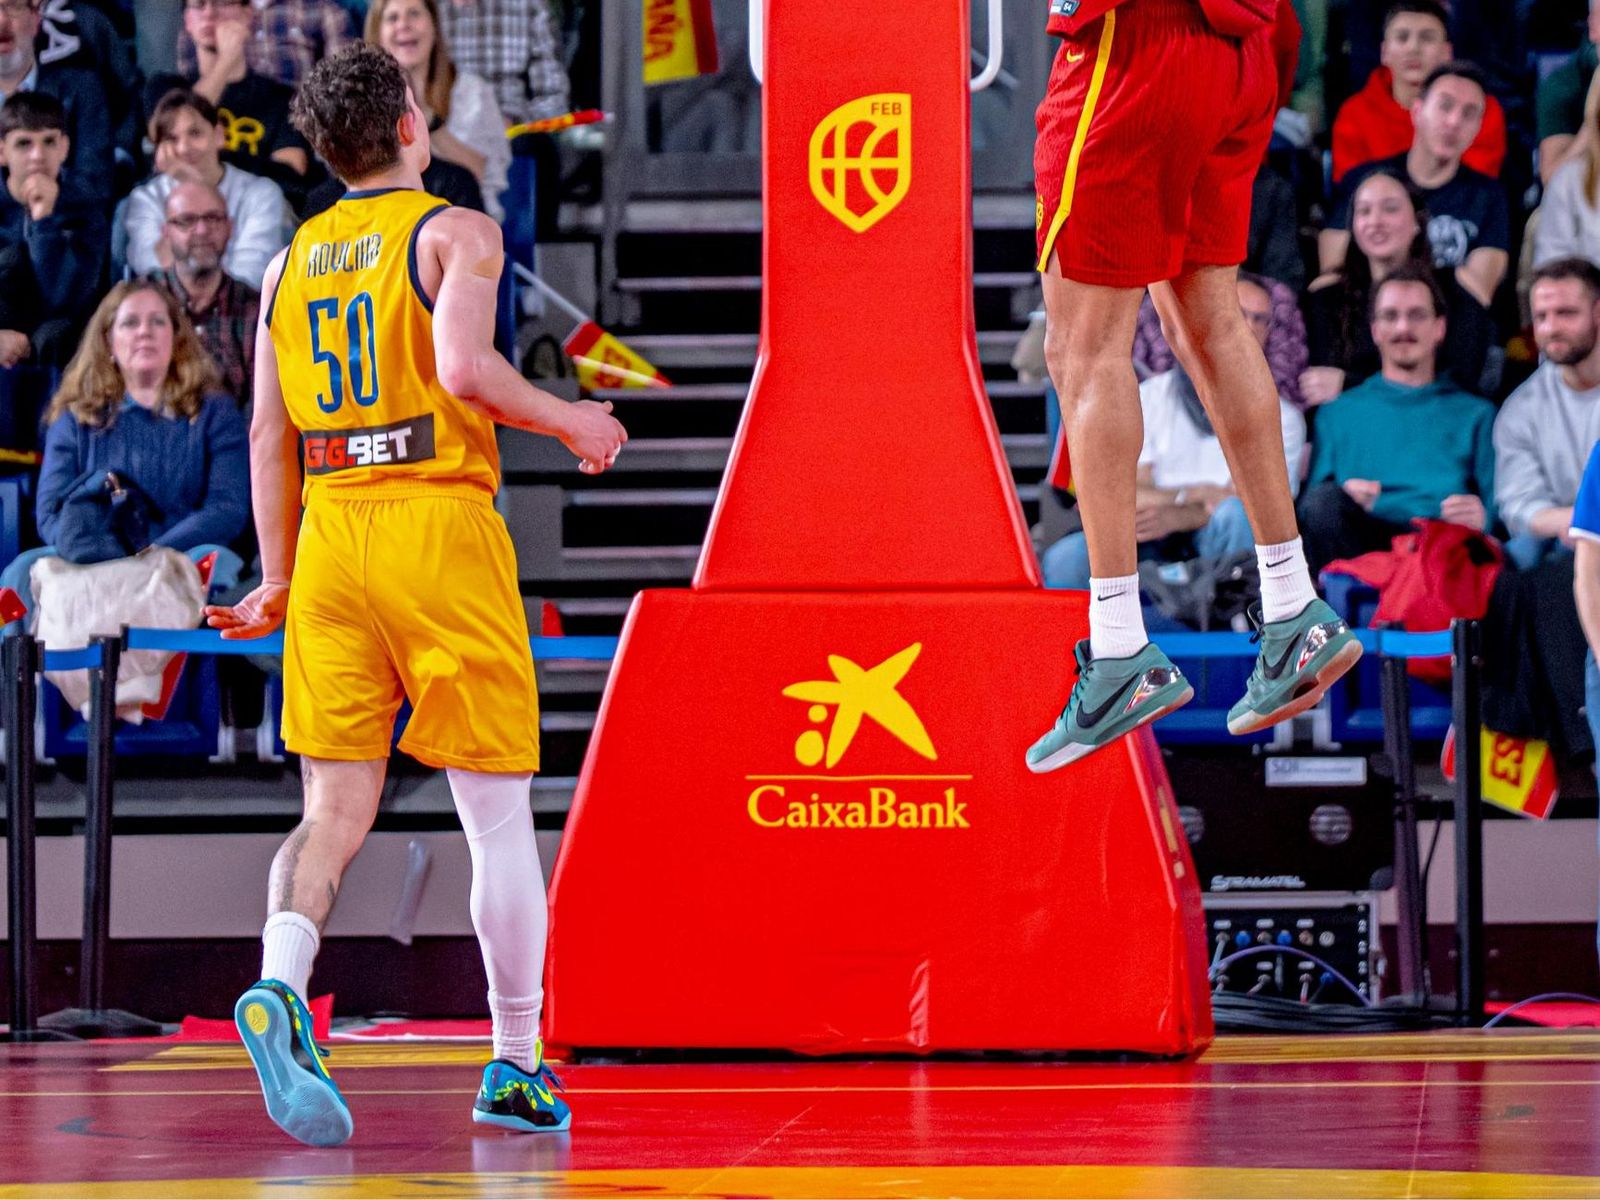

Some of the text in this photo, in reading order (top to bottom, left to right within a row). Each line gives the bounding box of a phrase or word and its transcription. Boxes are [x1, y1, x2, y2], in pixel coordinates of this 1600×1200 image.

[871, 102, 902, 115] FEB
[307, 291, 380, 414] 50
[305, 426, 412, 468] GG.BET
[747, 785, 971, 827] CaixaBank
